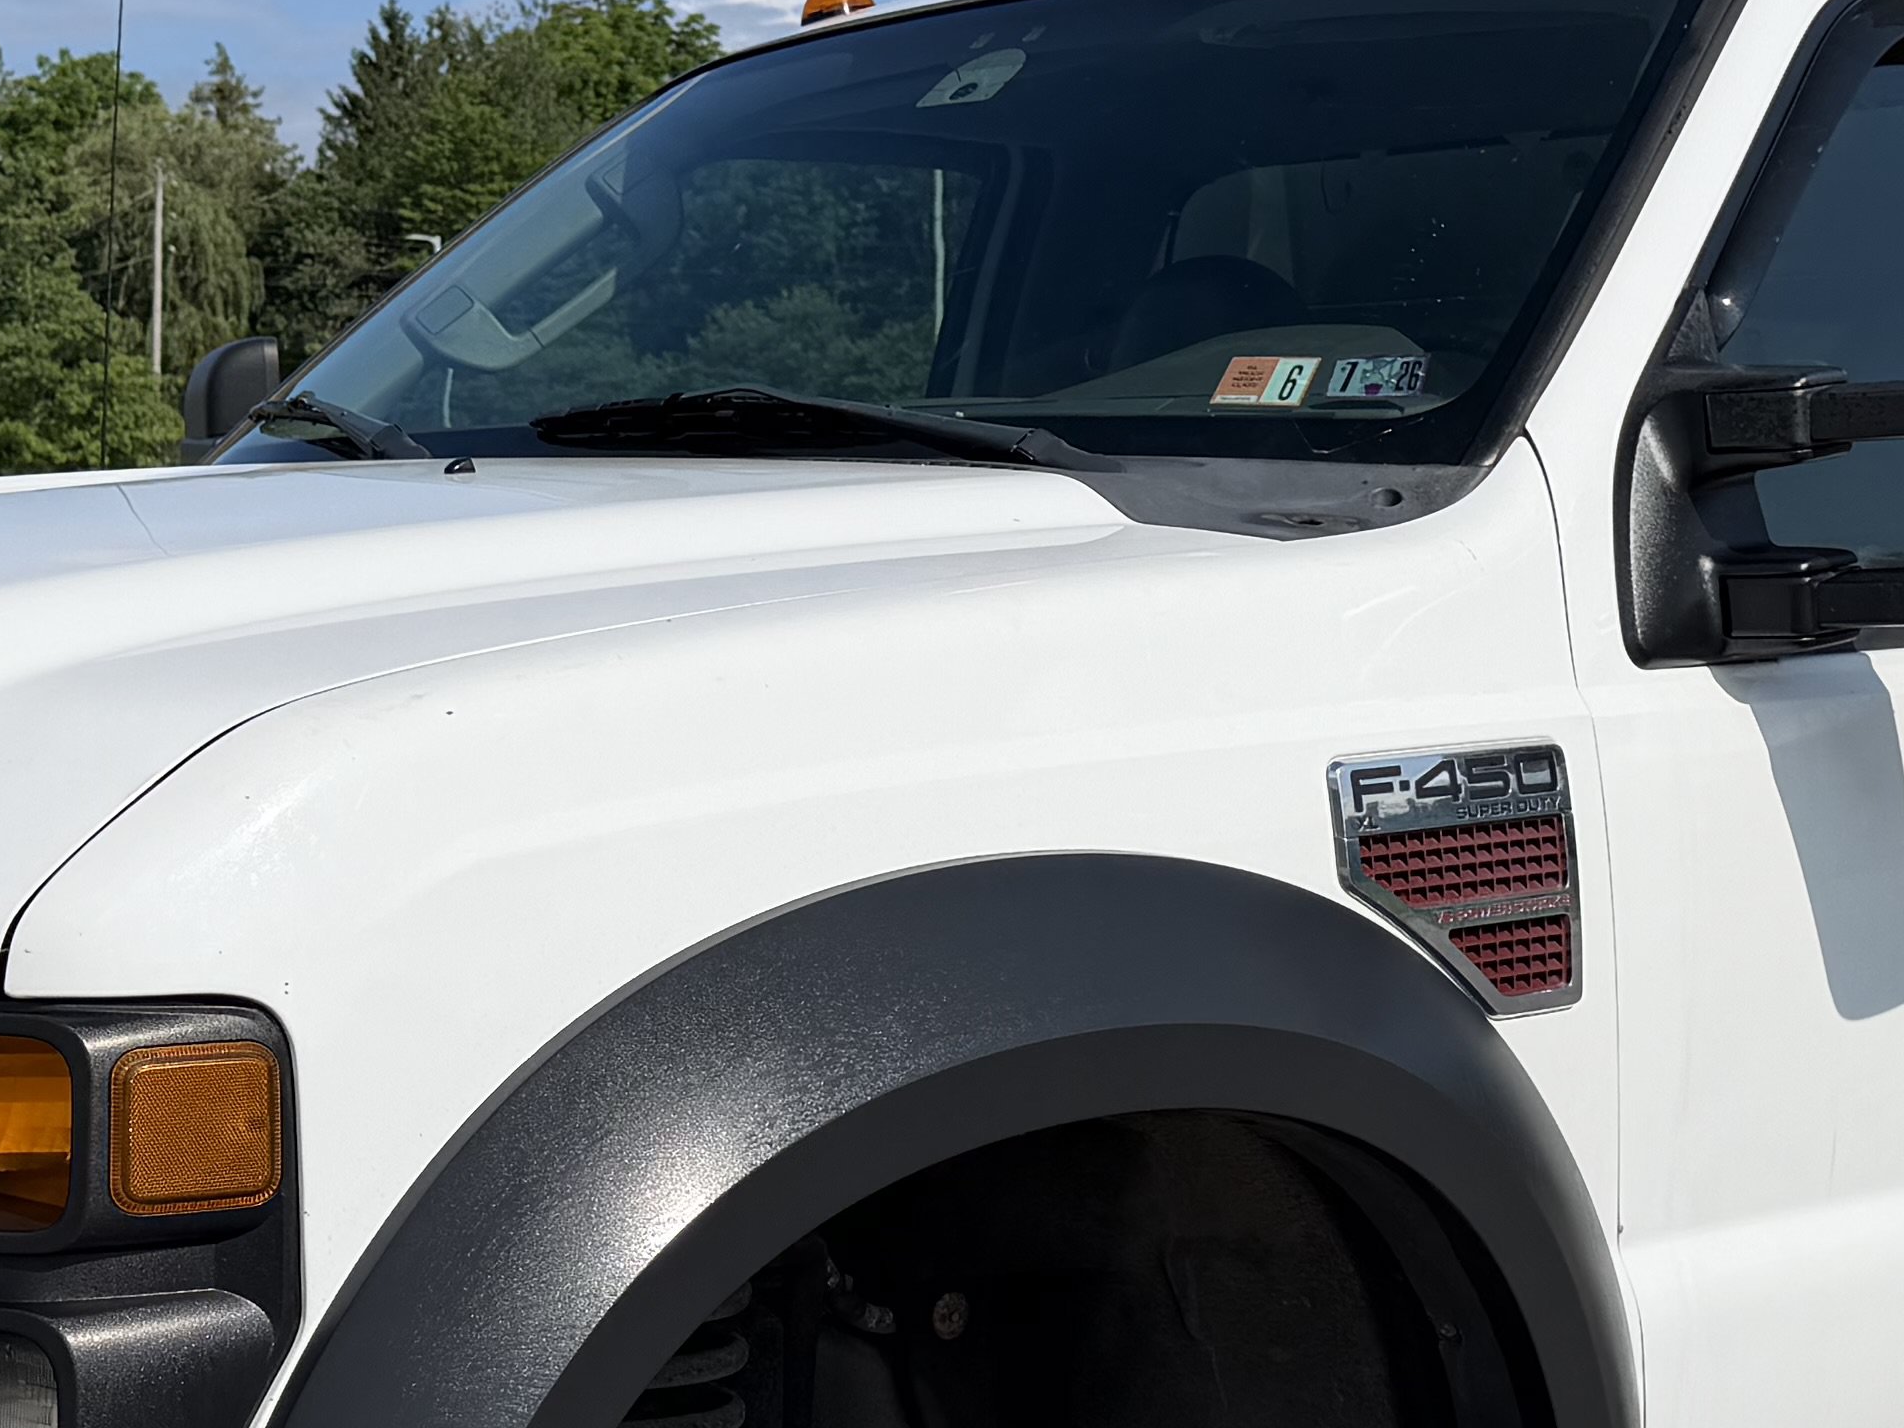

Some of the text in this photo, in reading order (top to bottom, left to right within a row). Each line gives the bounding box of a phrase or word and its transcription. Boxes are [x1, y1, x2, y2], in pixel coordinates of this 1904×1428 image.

[1277, 364, 1304, 402] 6
[1395, 360, 1423, 391] 26
[1350, 751, 1560, 814] F-450
[1456, 795, 1561, 820] SUPER DUTY
